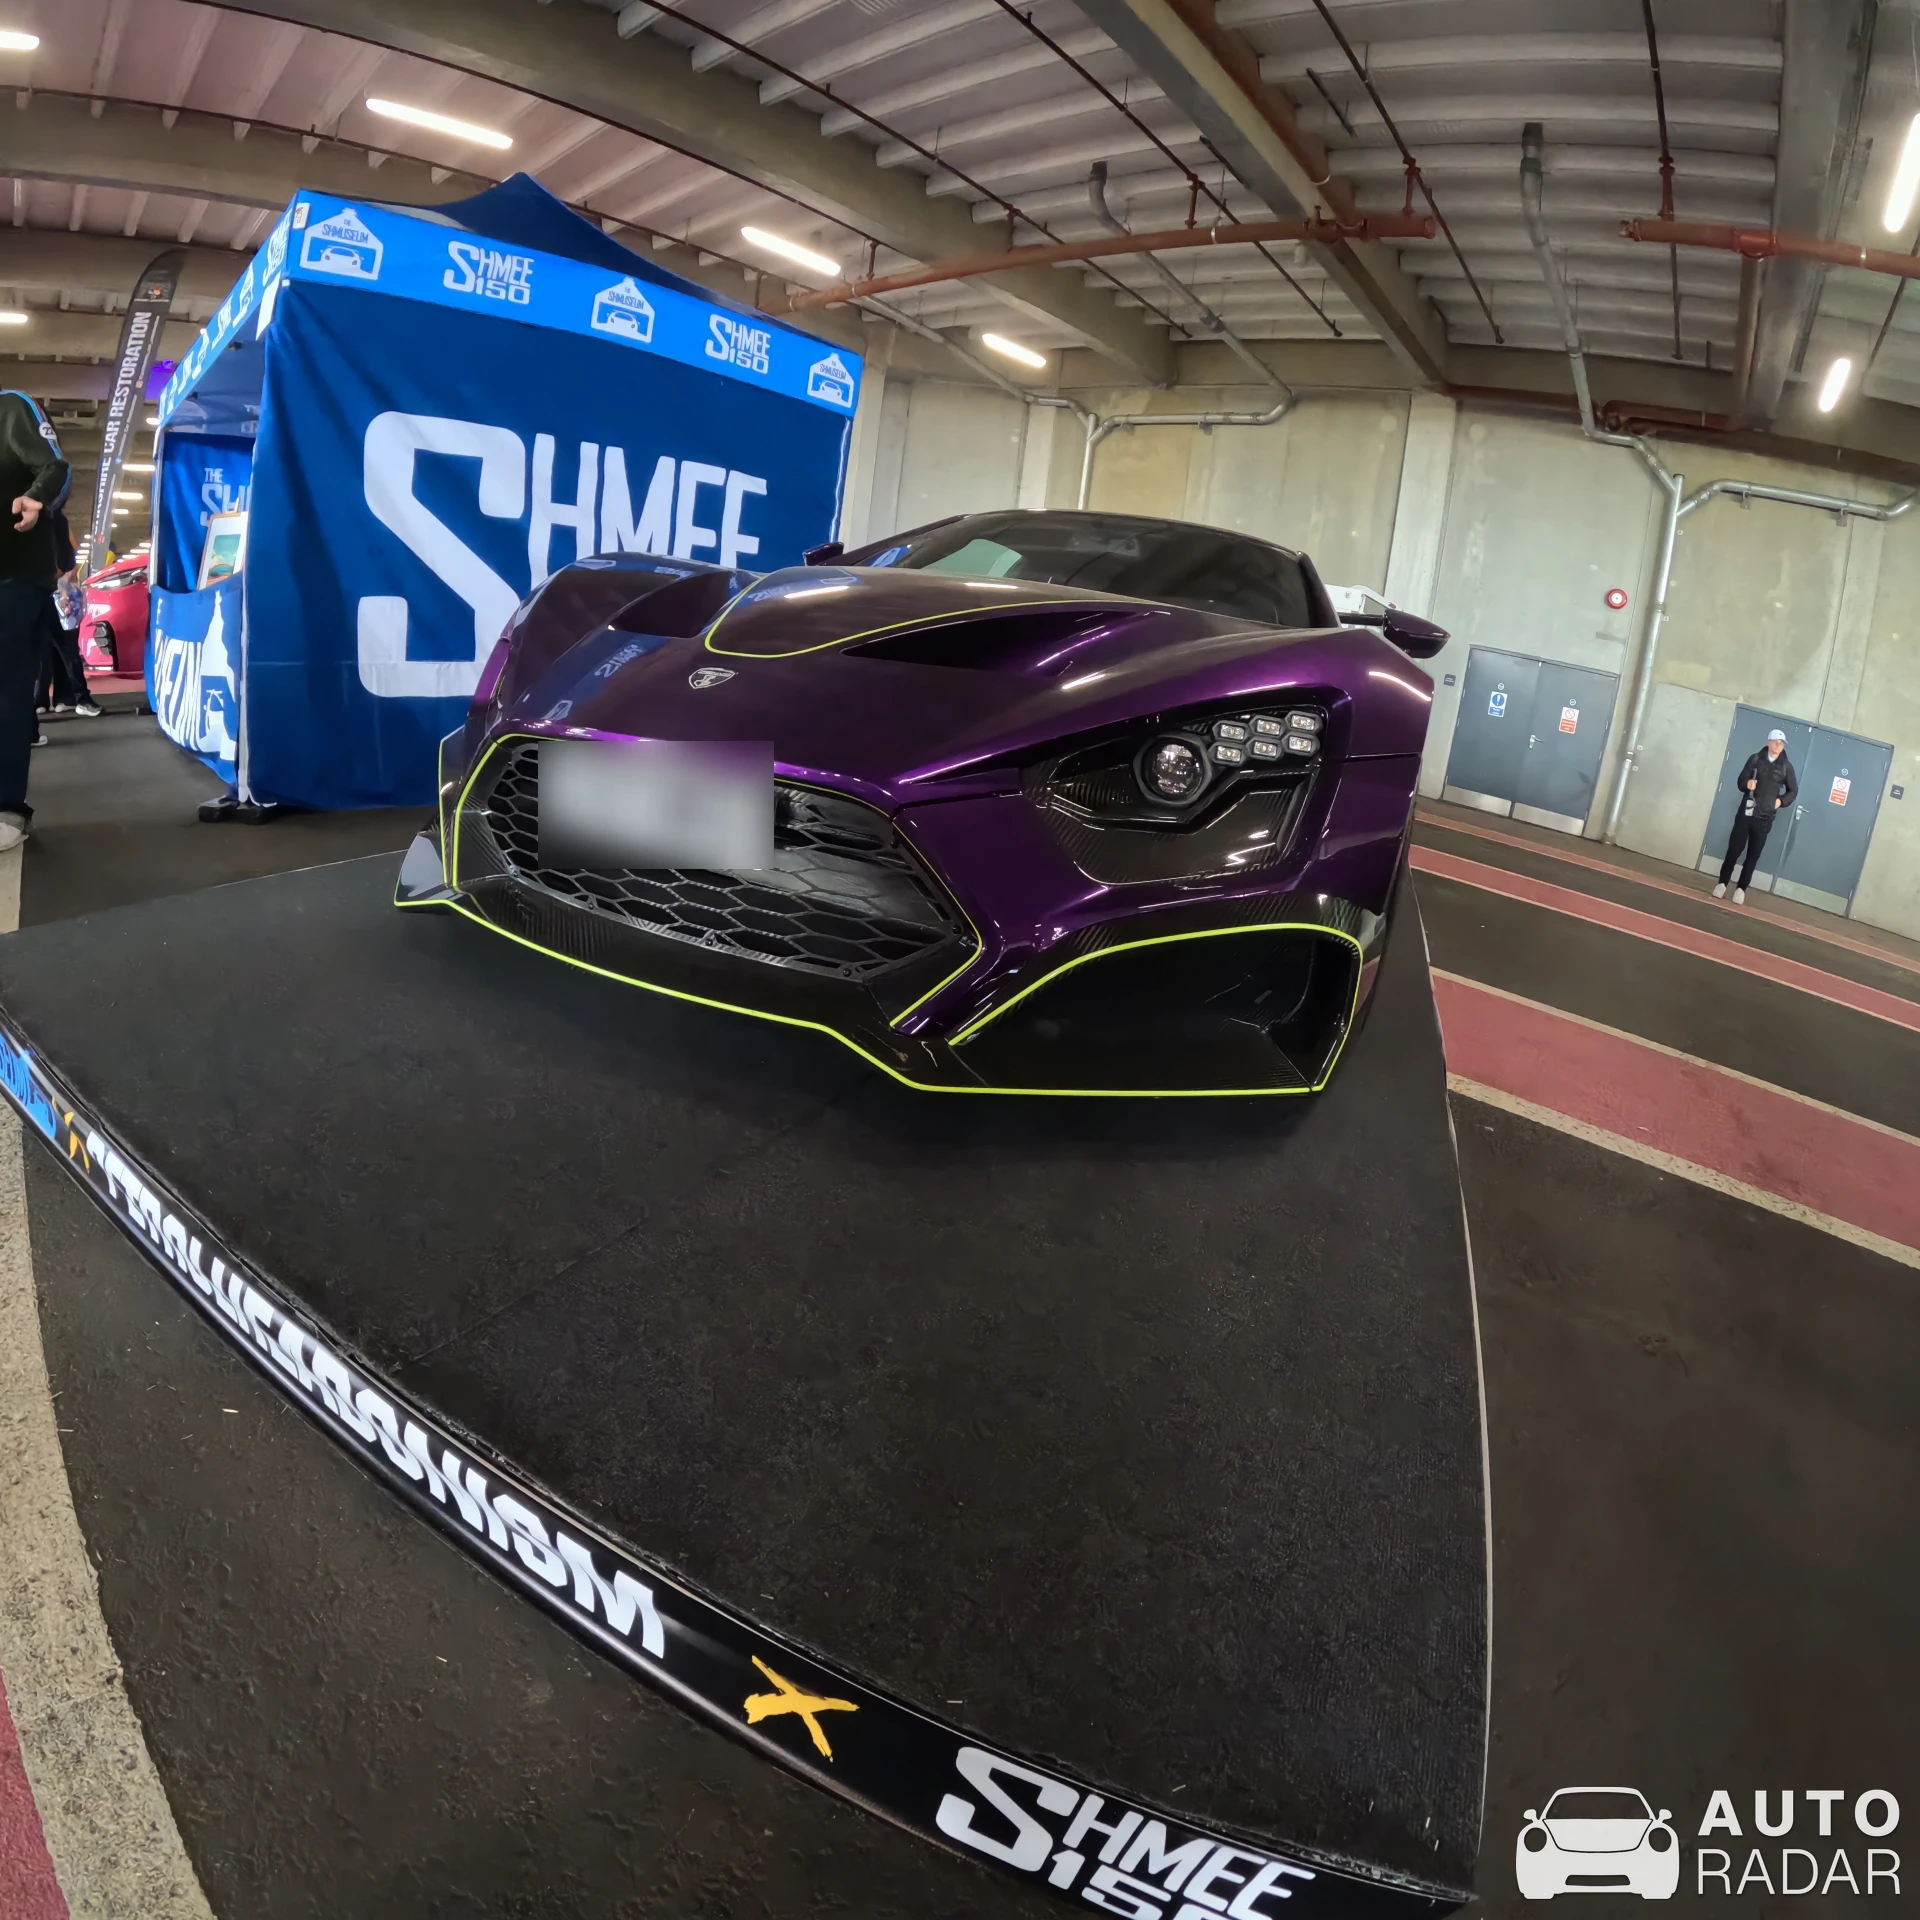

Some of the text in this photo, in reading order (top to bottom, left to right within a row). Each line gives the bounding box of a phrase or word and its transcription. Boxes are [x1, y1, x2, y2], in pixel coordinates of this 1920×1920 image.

[443, 240, 535, 293] SHMEE
[475, 278, 531, 305] 150
[704, 313, 772, 361] SHMEE
[728, 347, 768, 375] 150
[109, 311, 152, 418] RESTORATION
[103, 420, 121, 454] CAR
[204, 467, 223, 482] THE
[357, 410, 768, 698] SHMEE
[935, 1745, 1316, 1920] SHMEE
